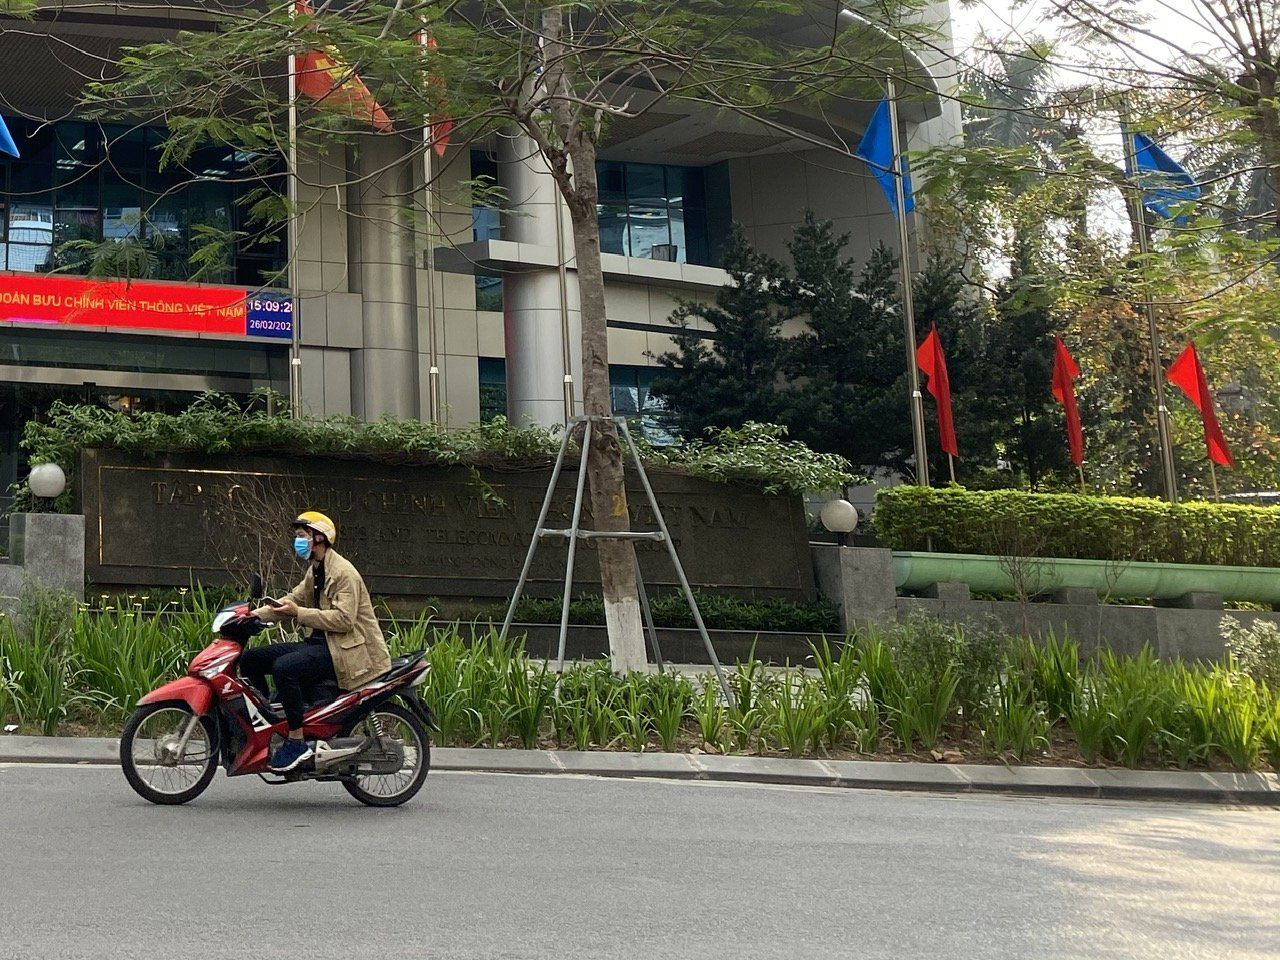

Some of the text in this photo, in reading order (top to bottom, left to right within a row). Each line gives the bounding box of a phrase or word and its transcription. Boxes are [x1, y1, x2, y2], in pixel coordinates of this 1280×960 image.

[33, 293, 62, 307] BƯU
[214, 304, 245, 319] NAM
[248, 299, 293, 313] 15:09:2
[249, 319, 292, 331] 26/02/202
